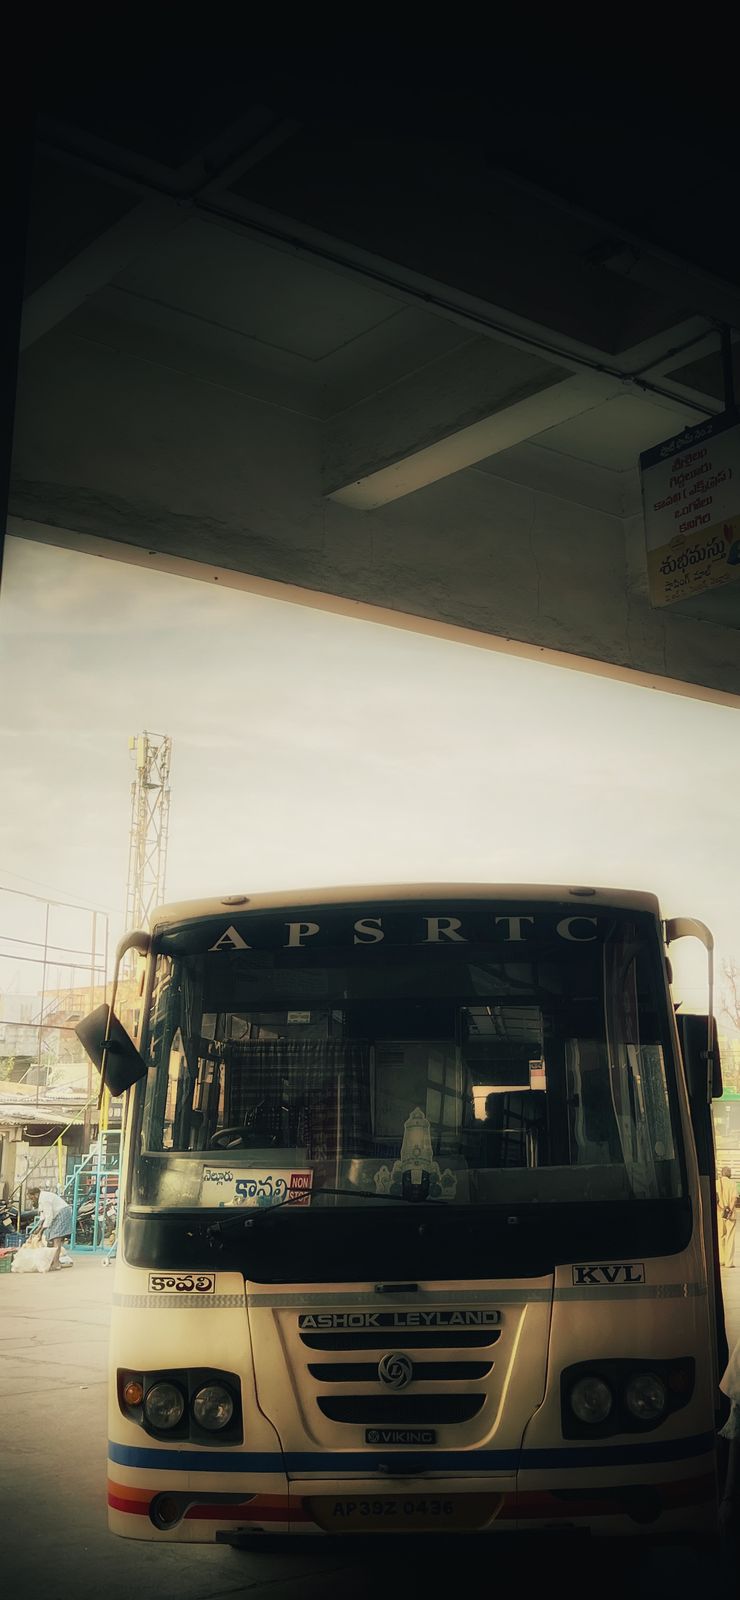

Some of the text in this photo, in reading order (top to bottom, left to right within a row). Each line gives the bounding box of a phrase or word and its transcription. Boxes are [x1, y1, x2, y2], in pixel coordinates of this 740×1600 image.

[659, 536, 727, 576] శుభమస్తు
[292, 1177, 309, 1188] NON
[575, 1265, 642, 1284] KVL
[151, 1275, 213, 1292] కావలి
[301, 1311, 499, 1328] ASHOK LEYLAND
[382, 1431, 433, 1443] VIKING
